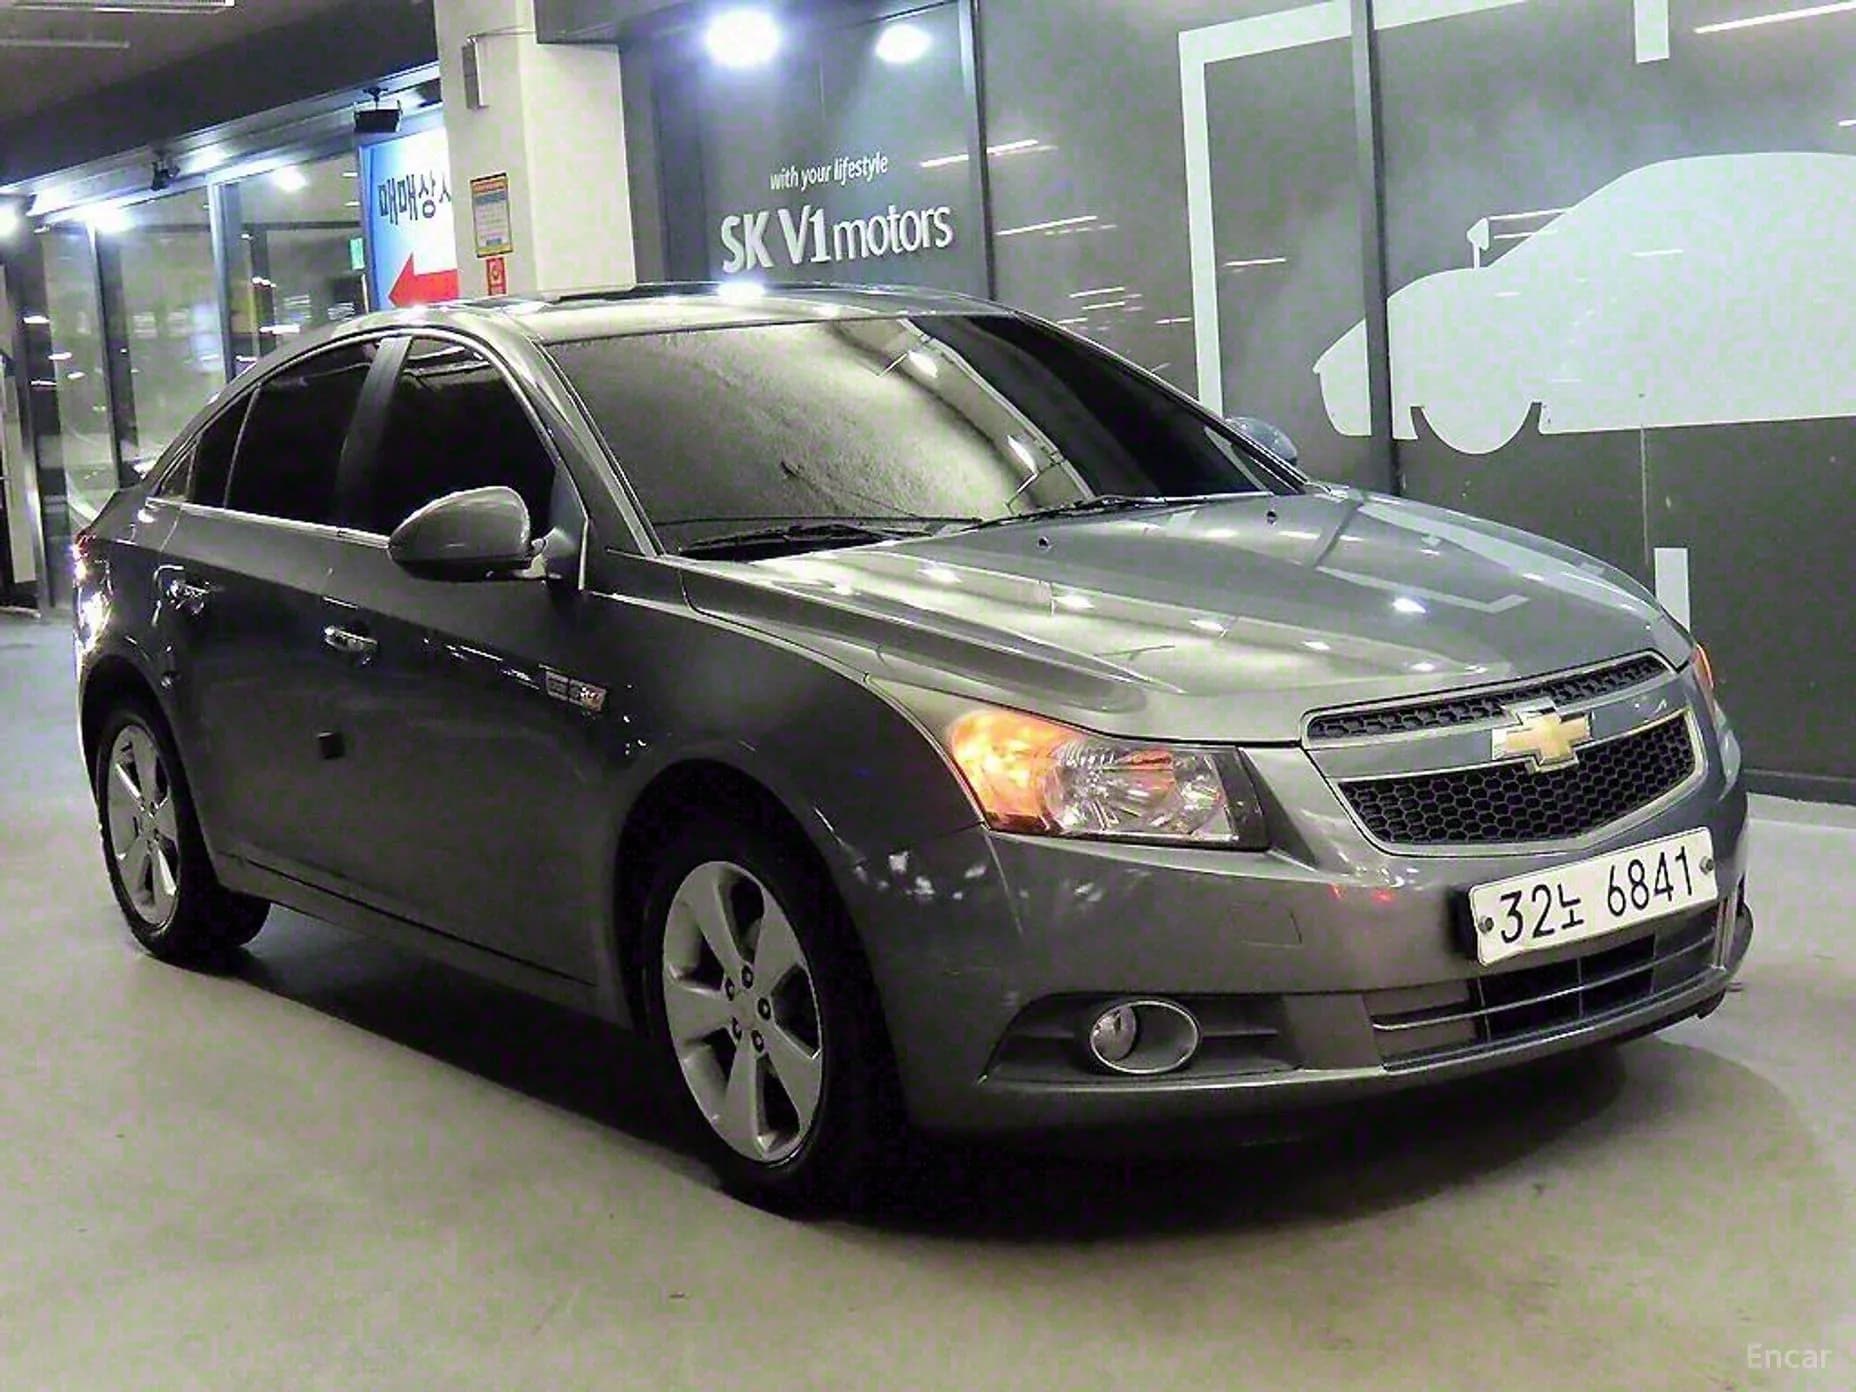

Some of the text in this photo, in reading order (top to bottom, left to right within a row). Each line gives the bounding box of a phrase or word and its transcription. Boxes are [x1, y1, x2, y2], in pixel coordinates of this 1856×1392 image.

[769, 152, 889, 192] with your lifestyle
[720, 210, 774, 273] SK
[1500, 845, 1693, 944] 32노 6841
